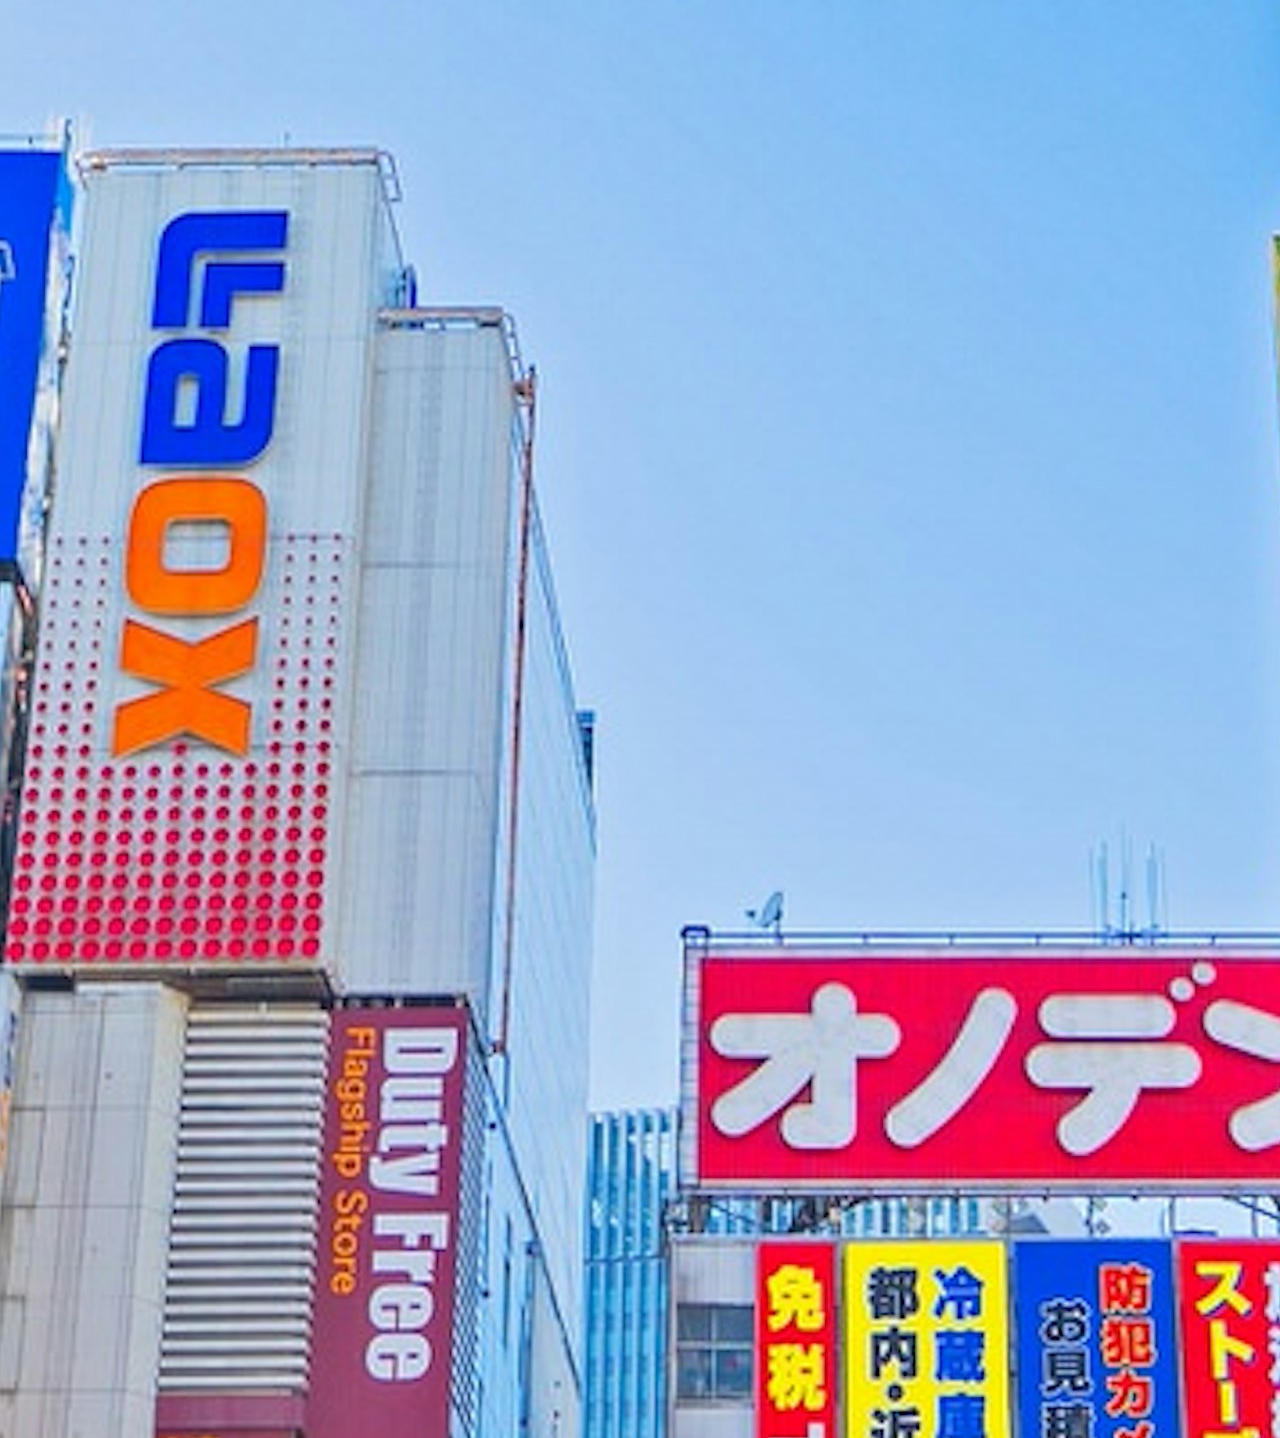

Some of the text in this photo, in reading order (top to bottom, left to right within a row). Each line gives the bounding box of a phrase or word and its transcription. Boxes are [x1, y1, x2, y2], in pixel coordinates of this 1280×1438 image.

[330, 1026, 376, 1297] Flagship Store
[365, 1025, 459, 1381] Duty Free
[764, 1264, 827, 1416] 免税
